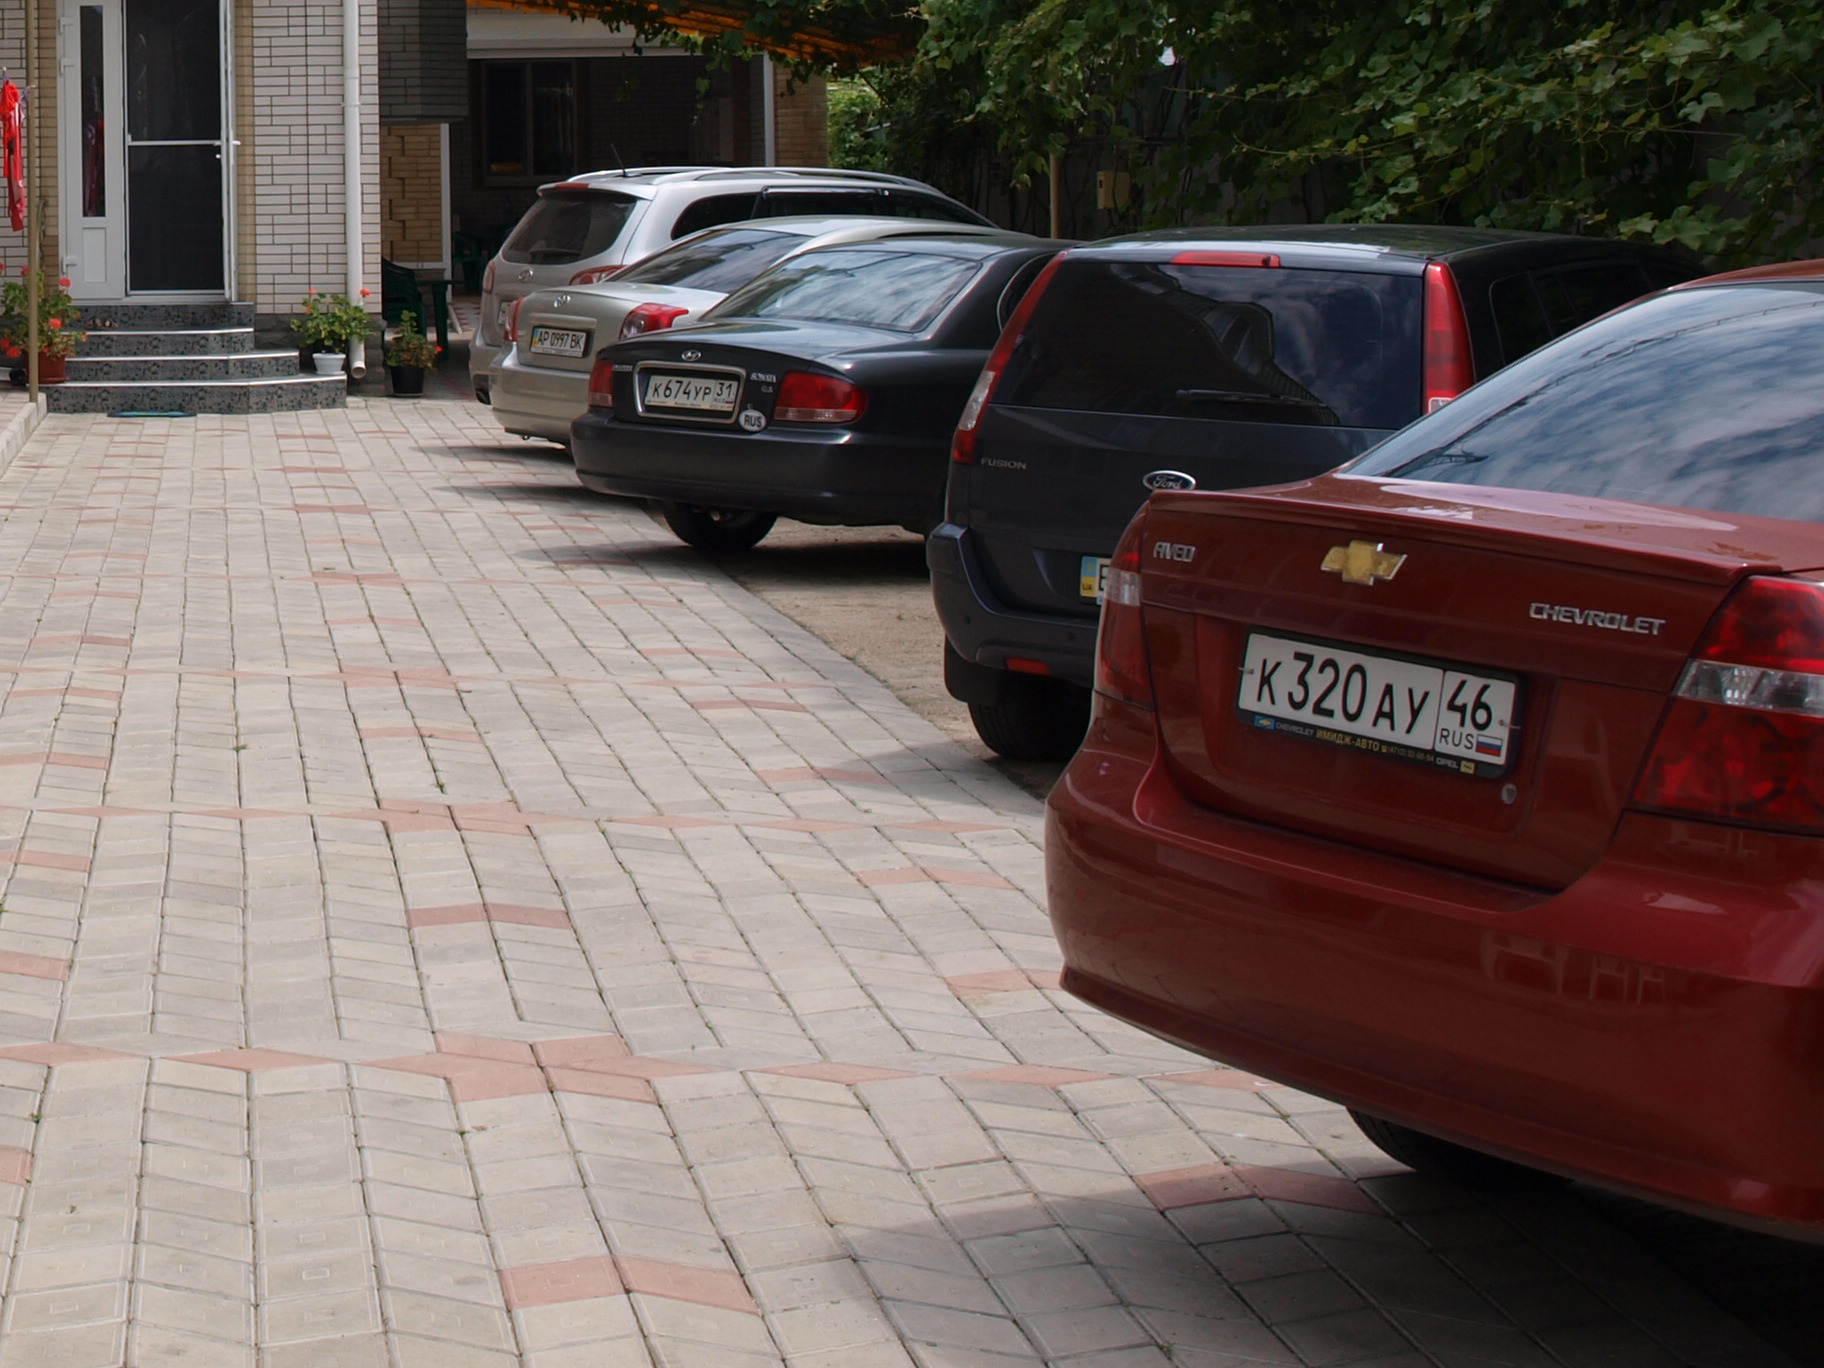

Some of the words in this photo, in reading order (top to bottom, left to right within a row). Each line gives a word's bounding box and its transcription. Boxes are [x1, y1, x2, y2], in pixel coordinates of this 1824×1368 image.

[716, 382, 733, 398] 31
[744, 414, 762, 428] RUS
[981, 458, 1028, 470] FUSION
[1152, 475, 1182, 489] Ford
[1153, 542, 1196, 562] AVEO
[1529, 602, 1666, 635] CHEVROLET
[1447, 679, 1493, 731] 46
[1439, 728, 1474, 750] RUS
[1436, 757, 1459, 769] OPEL
